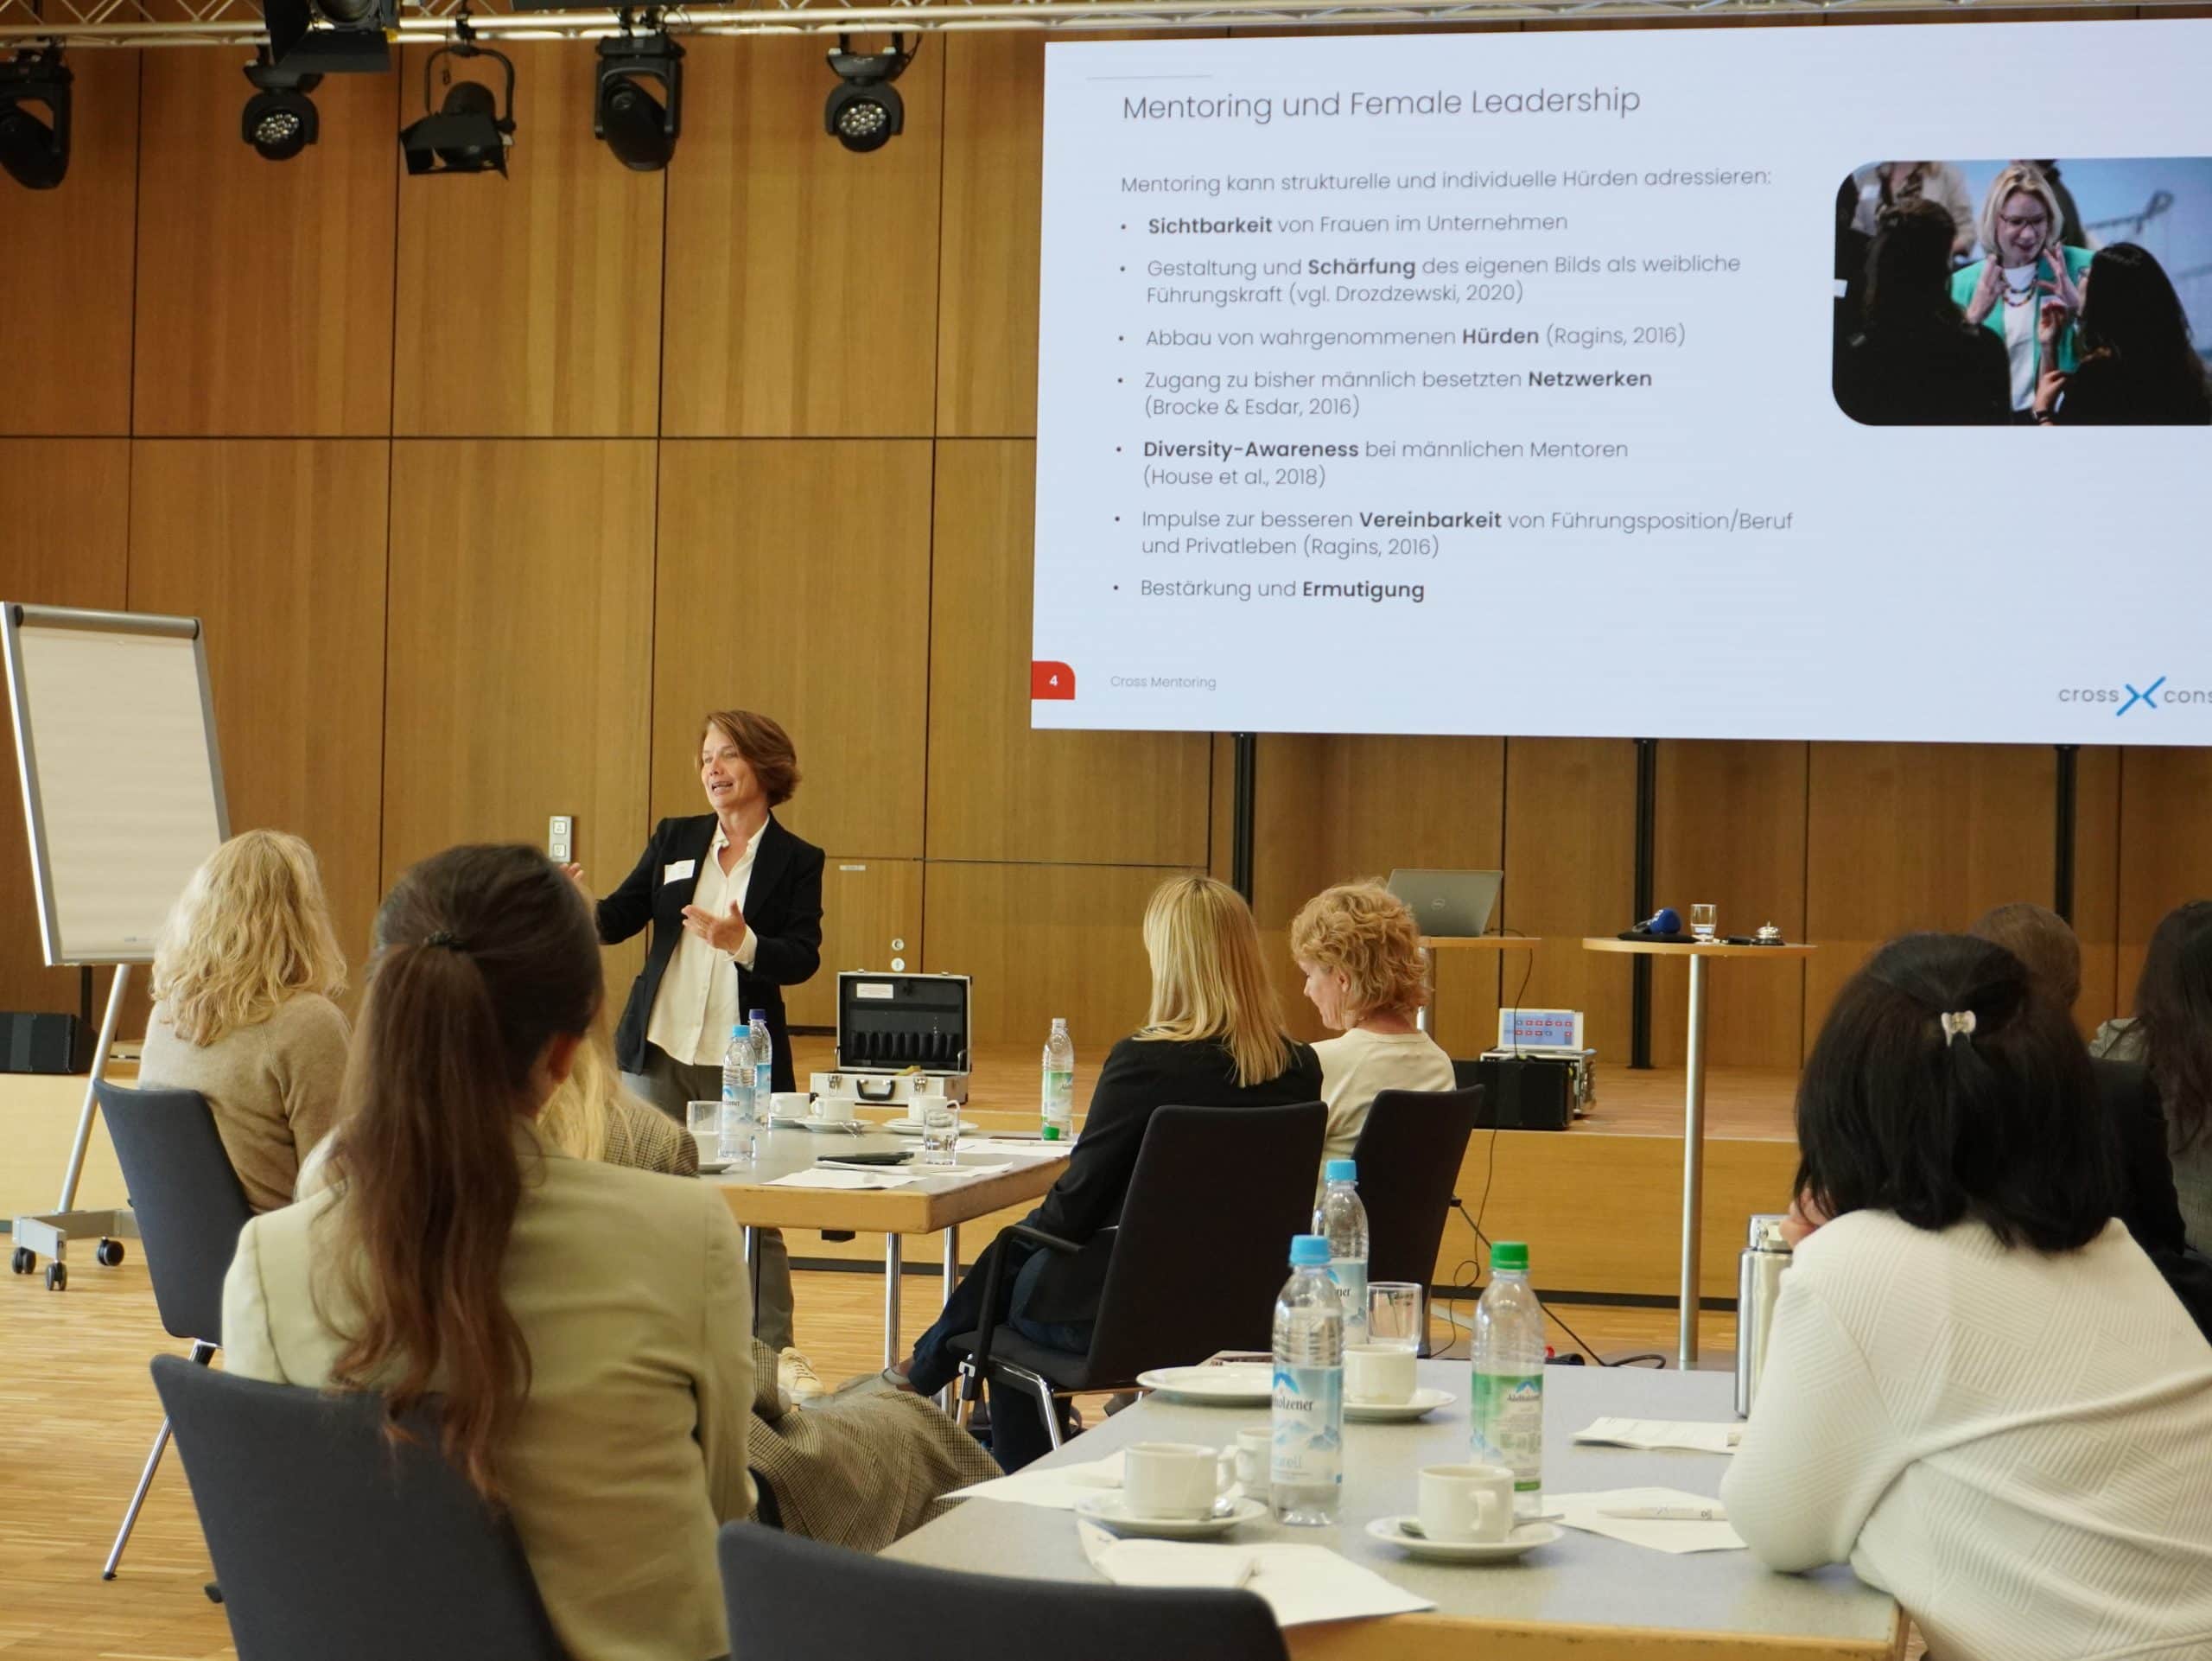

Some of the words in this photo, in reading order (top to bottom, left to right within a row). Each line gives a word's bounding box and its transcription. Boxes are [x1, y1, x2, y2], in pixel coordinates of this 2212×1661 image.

[1124, 93, 1272, 124] Mentoring
[1283, 91, 1339, 118] und
[1351, 90, 1462, 116] Female
[1472, 86, 1640, 119] Leadership
[1122, 175, 1220, 197] Mentoring
[1227, 175, 1274, 191] kann
[1281, 173, 1390, 190] strukturelle
[1397, 172, 1436, 188] und
[1442, 170, 1557, 188] individuelle
[1562, 169, 1637, 187] Hürden
[1644, 168, 1770, 187] adressieren:
[1148, 216, 1273, 235] Sichtbarkeit
[1278, 220, 1313, 233] von
[1320, 216, 1389, 232] Frauen
[1396, 215, 1421, 232] im
[1427, 214, 1567, 231] Unternehmen
[1147, 259, 1256, 281] Gestaltung
[1263, 258, 1301, 275] und
[1308, 257, 1415, 280] Schärfung
[1422, 257, 1459, 274] des
[1465, 257, 1548, 278] eigenen
[1555, 256, 1601, 273] Bilds
[1607, 256, 1636, 273] als
[1642, 254, 1741, 272] weibliche
[1147, 286, 1282, 308] Führungskraft
[1289, 282, 1330, 308] (vgl.
[1336, 284, 1460, 304] Drozdzewski,
[1466, 280, 1522, 304] 2020)
[1146, 329, 1211, 346] Abbau
[1217, 333, 1254, 346] von
[1260, 328, 1456, 350] wahrgenommenen
[1463, 328, 1539, 345] Hürden
[1547, 323, 1627, 349] (Ragins,
[1633, 322, 1685, 347] 2016)
[1145, 372, 1221, 393] Zugang
[1227, 375, 1248, 387] zu
[1255, 371, 1315, 387] bisher
[1322, 371, 1415, 387] männlich
[1422, 371, 1521, 387] besetzten
[1529, 370, 1652, 387] Netzwerken
[1146, 392, 1218, 418] (Brocke
[1224, 398, 1239, 415] &
[1245, 398, 1303, 417] Esdar,
[1309, 394, 1359, 418] 2016)
[1143, 440, 1359, 462] Diversity-Awareness
[1365, 441, 1395, 457] bei
[1402, 440, 1523, 458] männlichen
[1530, 442, 1628, 458] Mentoren
[1144, 464, 1213, 488] (House
[1219, 470, 1237, 485] et
[1244, 468, 1269, 487] al.,
[1275, 464, 1325, 489] 2018)
[1143, 510, 1220, 532] Impulse
[1226, 514, 1255, 527] zur
[1262, 510, 1352, 527] besseren
[1359, 510, 1502, 528] Vereinbarkeit
[1507, 513, 1545, 528] von
[1551, 508, 1793, 534] Führungsposition/Beruf
[1142, 537, 1179, 553] und
[1185, 537, 1296, 555] Privatleben
[1304, 534, 1382, 560] (Ragins,
[1388, 534, 1439, 559] 2016)
[1141, 580, 1251, 601] Bestärkung
[1258, 581, 1296, 597] und
[1302, 580, 1424, 603] Ermutigung
[1049, 676, 1058, 687] 4
[1111, 676, 1147, 687] Cross
[1151, 676, 1217, 690] Mentoring
[2059, 689, 2120, 703] cross
